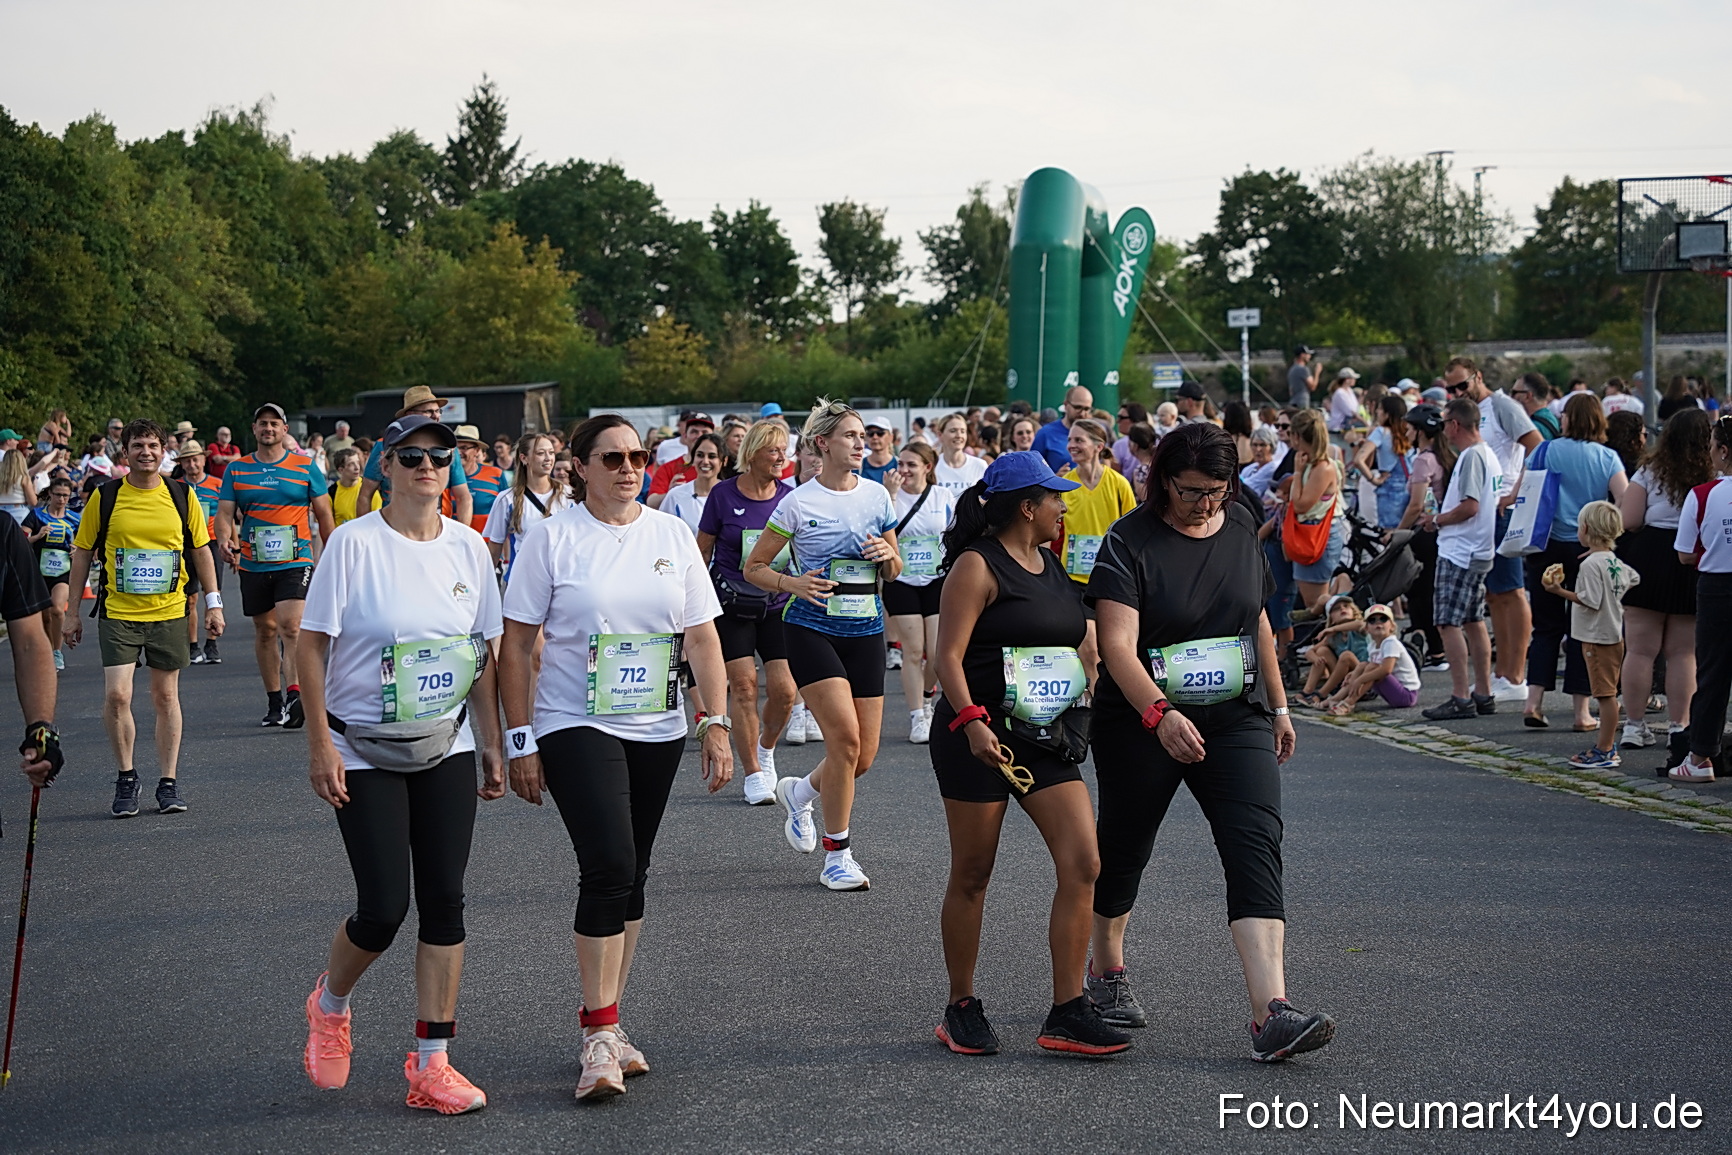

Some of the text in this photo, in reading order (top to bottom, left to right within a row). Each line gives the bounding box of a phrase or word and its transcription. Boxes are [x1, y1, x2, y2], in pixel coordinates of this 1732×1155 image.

[1113, 250, 1138, 317] AOK
[1064, 371, 1079, 386] AO
[1104, 371, 1119, 386] AO
[907, 552, 932, 561] 2728
[1081, 551, 1098, 560] 23
[132, 567, 163, 577] 2339
[417, 672, 454, 691] 709
[619, 667, 647, 683] 712
[1182, 670, 1225, 687] 2313
[611, 686, 654, 696] Margit Niebler
[1027, 680, 1071, 696] 2307
[418, 693, 437, 703] Karin
[437, 691, 455, 700] Fürst
